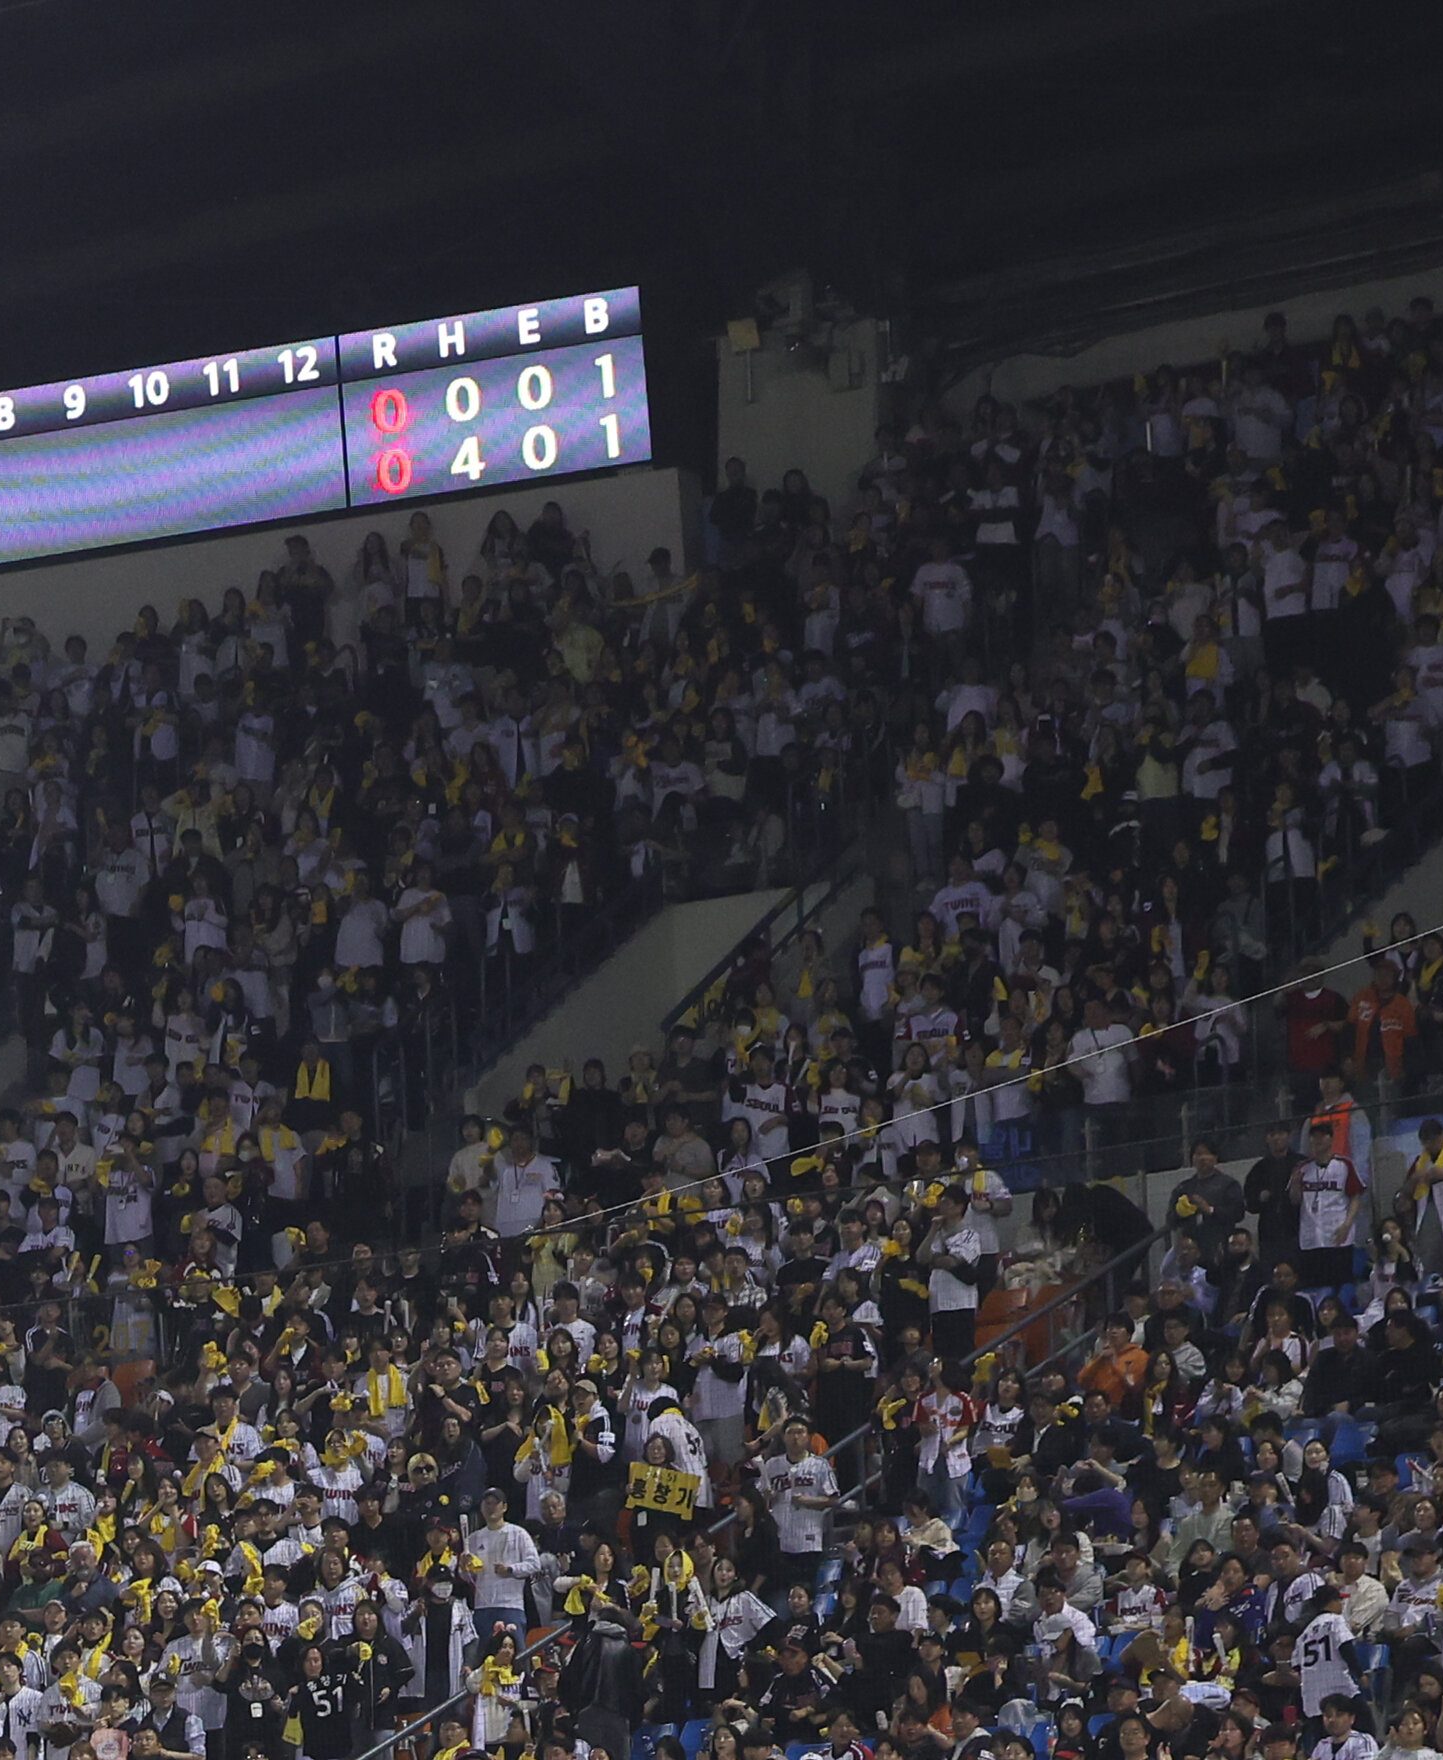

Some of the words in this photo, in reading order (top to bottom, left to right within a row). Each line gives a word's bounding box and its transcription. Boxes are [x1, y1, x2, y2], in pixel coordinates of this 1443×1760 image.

[372, 333, 397, 370] R
[438, 322, 465, 358] H
[518, 309, 541, 344] E
[584, 297, 610, 333] B
[64, 386, 86, 420] 9
[129, 371, 169, 408] 10
[203, 360, 241, 396] 11
[278, 346, 320, 384] 12
[371, 389, 407, 433] 0
[446, 376, 480, 421] 0
[518, 364, 553, 411] 0
[595, 353, 615, 399] 1
[377, 449, 412, 493] 0
[450, 436, 485, 481] 4
[522, 425, 557, 470] 0
[599, 414, 620, 460] 1
[1303, 1637, 1331, 1667] 51
[312, 1685, 343, 1717] 51
